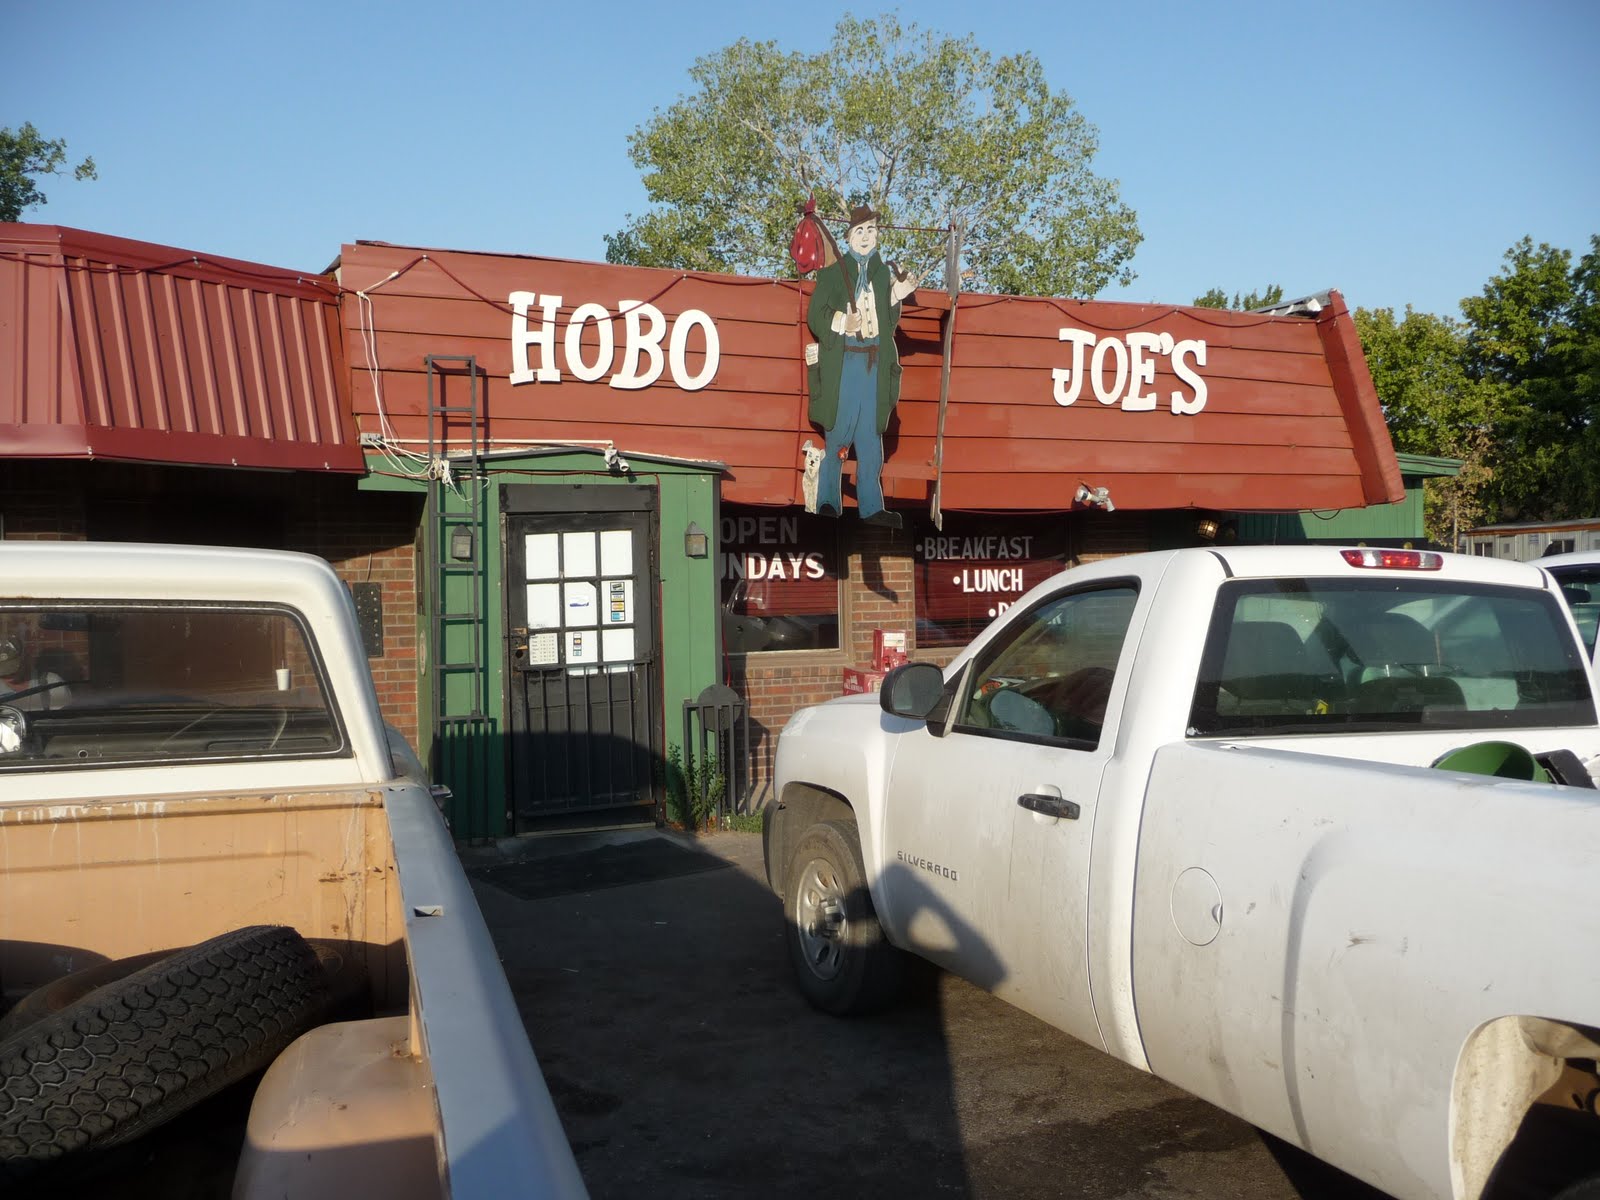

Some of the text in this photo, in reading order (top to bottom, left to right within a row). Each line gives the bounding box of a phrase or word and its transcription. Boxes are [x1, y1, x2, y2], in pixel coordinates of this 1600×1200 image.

[508, 291, 1208, 415] HOBO JOE'S
[719, 516, 798, 545] OPEN
[924, 536, 1034, 560] BREAKFAST
[719, 552, 825, 579] NDAYS
[963, 569, 1023, 593] LUNCH
[897, 850, 958, 881] SILVERADO
